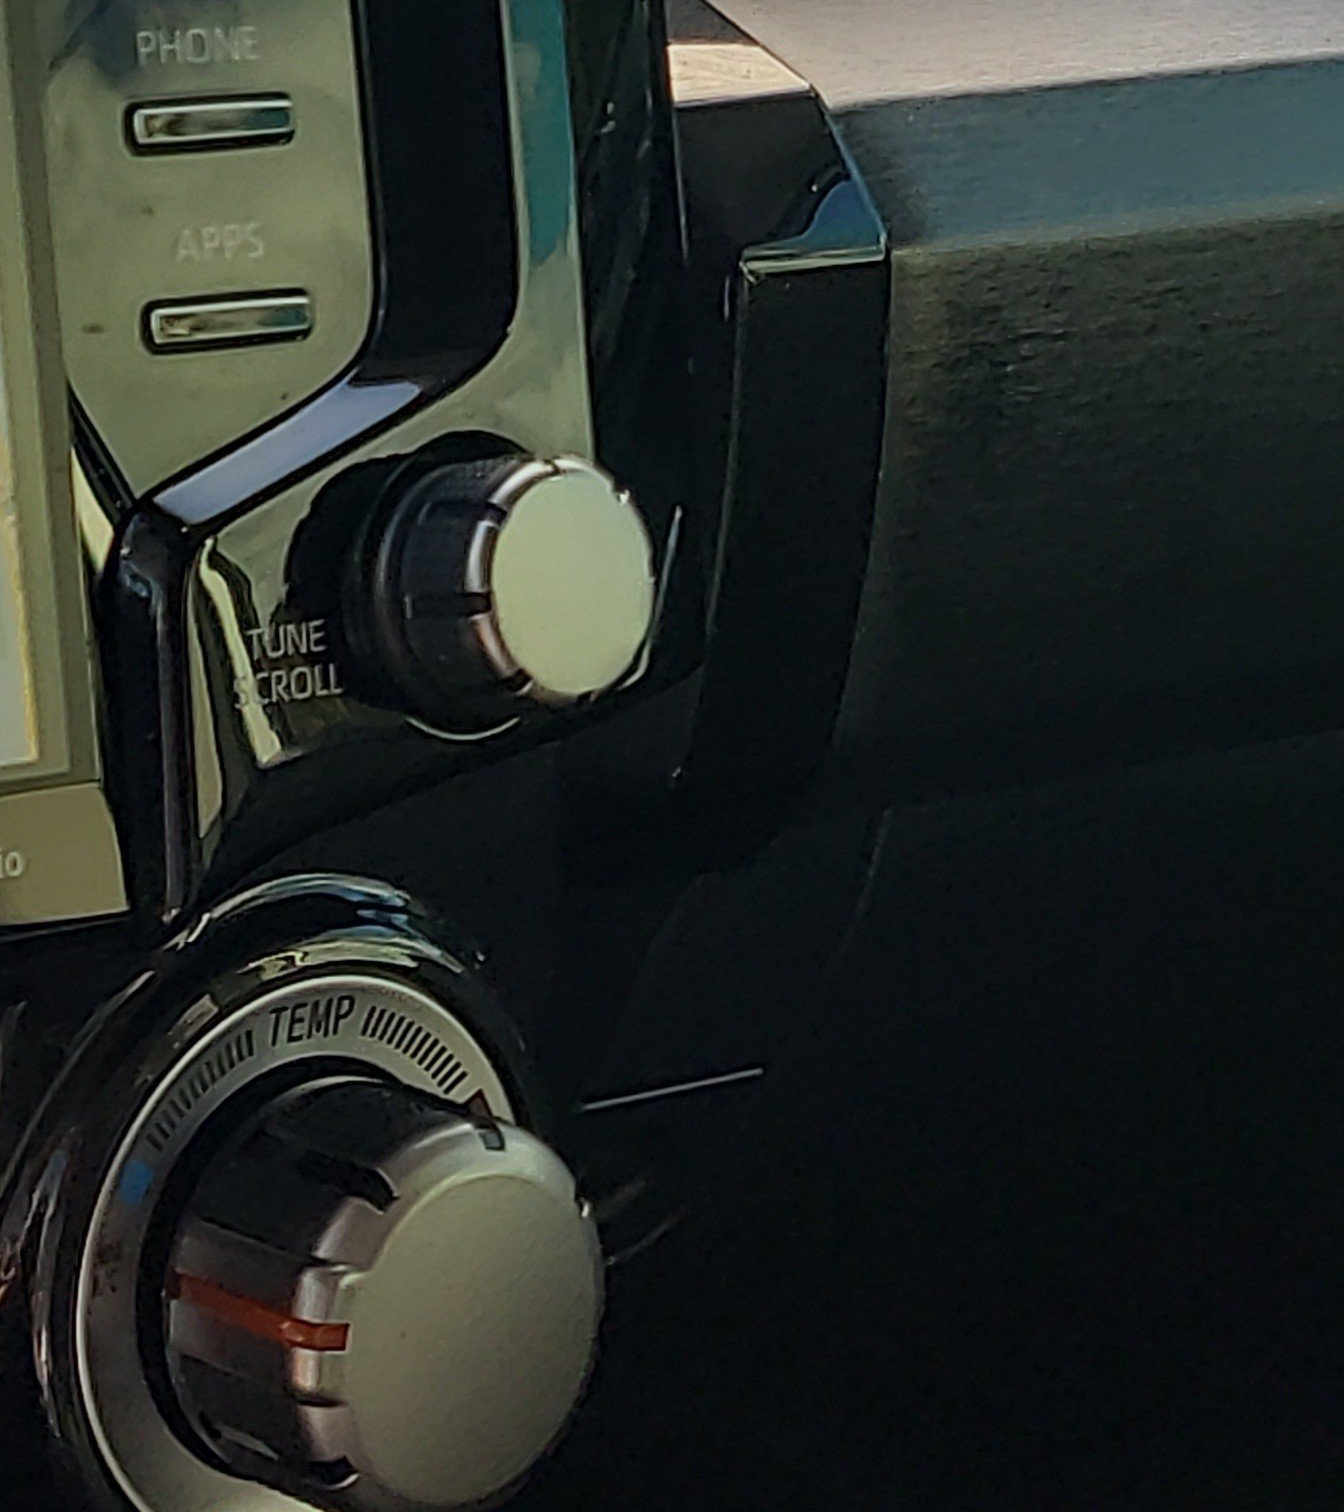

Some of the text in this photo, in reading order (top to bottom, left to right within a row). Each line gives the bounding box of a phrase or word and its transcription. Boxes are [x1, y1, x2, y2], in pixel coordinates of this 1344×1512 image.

[136, 27, 261, 65] PHONE
[175, 226, 265, 261] APPS
[243, 618, 328, 661] TUNE
[268, 993, 356, 1045] TEMP
